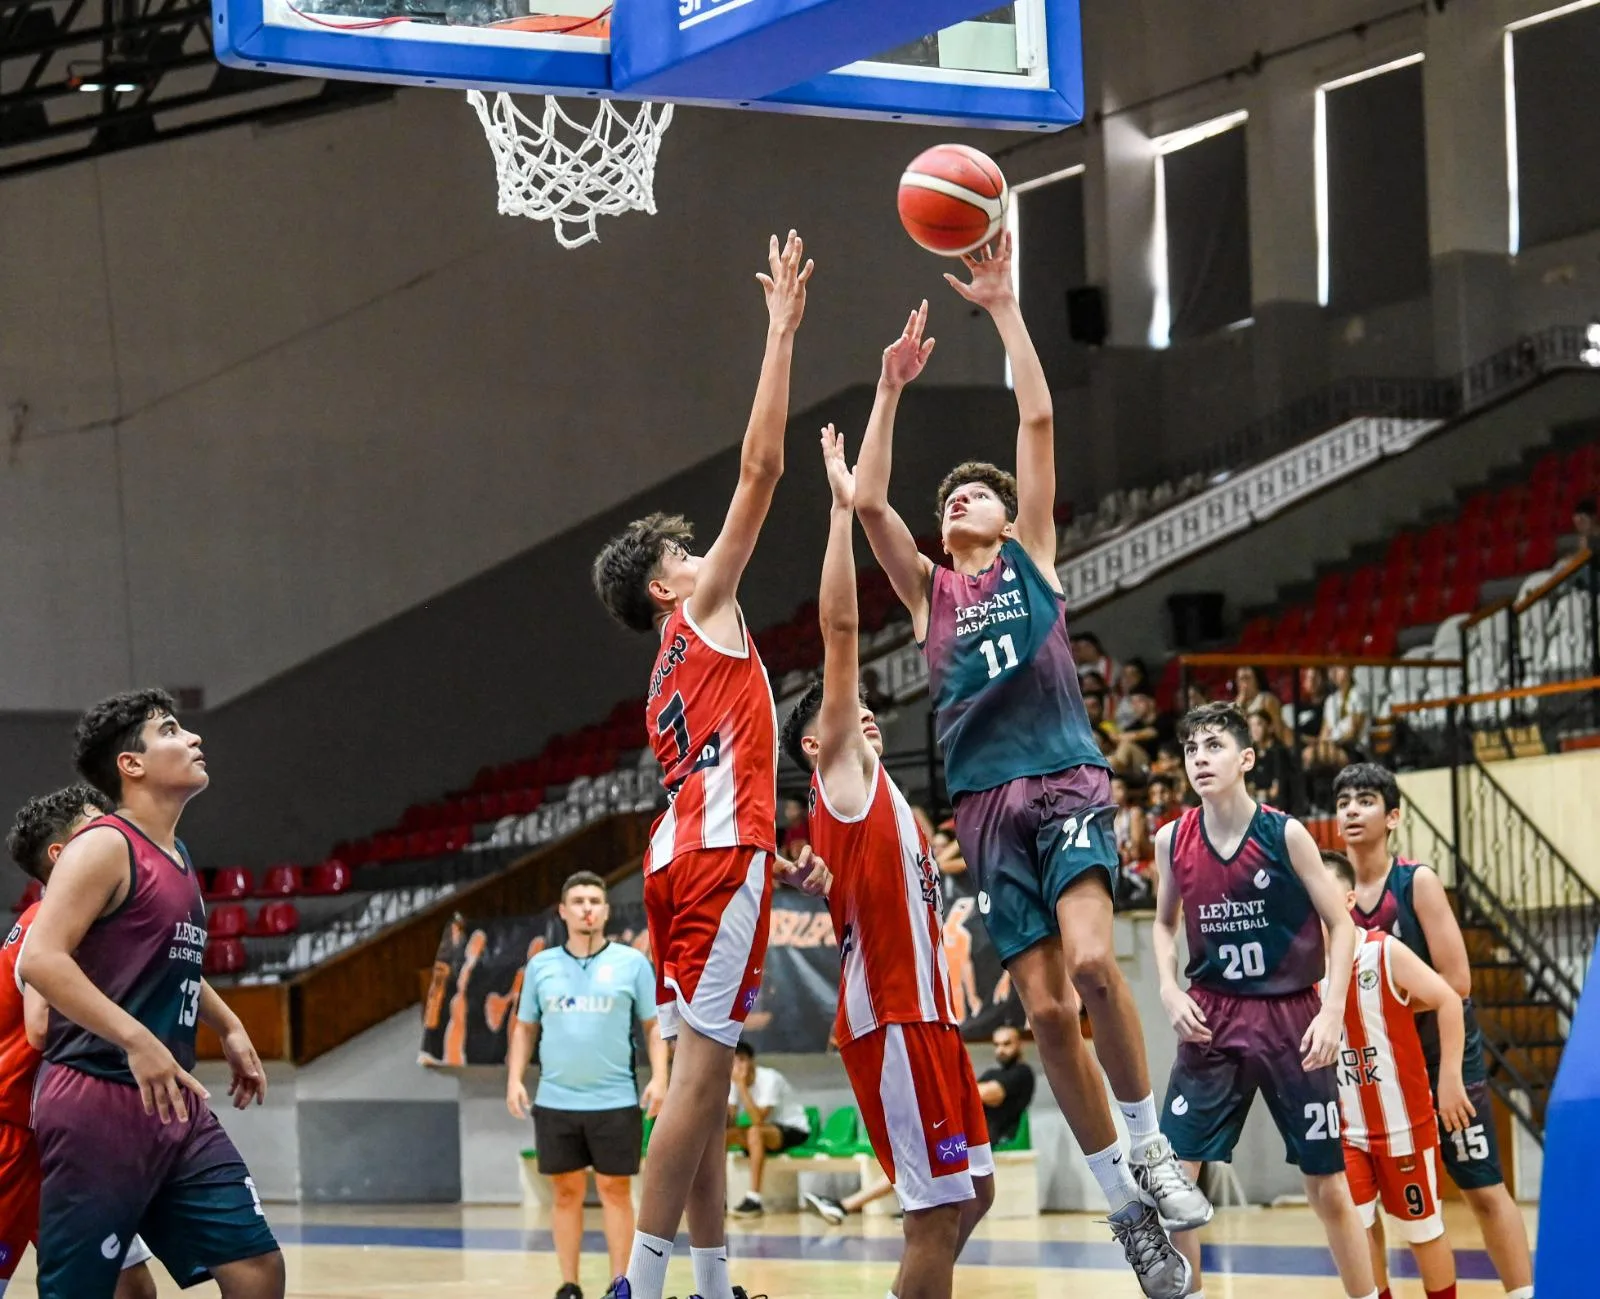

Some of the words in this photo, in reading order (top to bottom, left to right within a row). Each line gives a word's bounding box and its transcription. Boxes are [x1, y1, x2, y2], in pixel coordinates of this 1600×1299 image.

[956, 607, 1029, 637] BASKETBALL
[979, 634, 1019, 679] 11
[1198, 897, 1266, 920] LEVENT
[173, 921, 208, 947] LEVEN
[1200, 917, 1269, 933] BASKETBALL
[168, 946, 203, 965] BASKETB
[1218, 941, 1266, 980] 20
[178, 978, 201, 1028] 13
[545, 995, 614, 1013] ZORLU
[1341, 1046, 1378, 1067] OP
[1337, 1065, 1382, 1087] NK
[1303, 1100, 1340, 1141] 20
[1451, 1124, 1490, 1162] 15
[1404, 1184, 1425, 1216] 9
